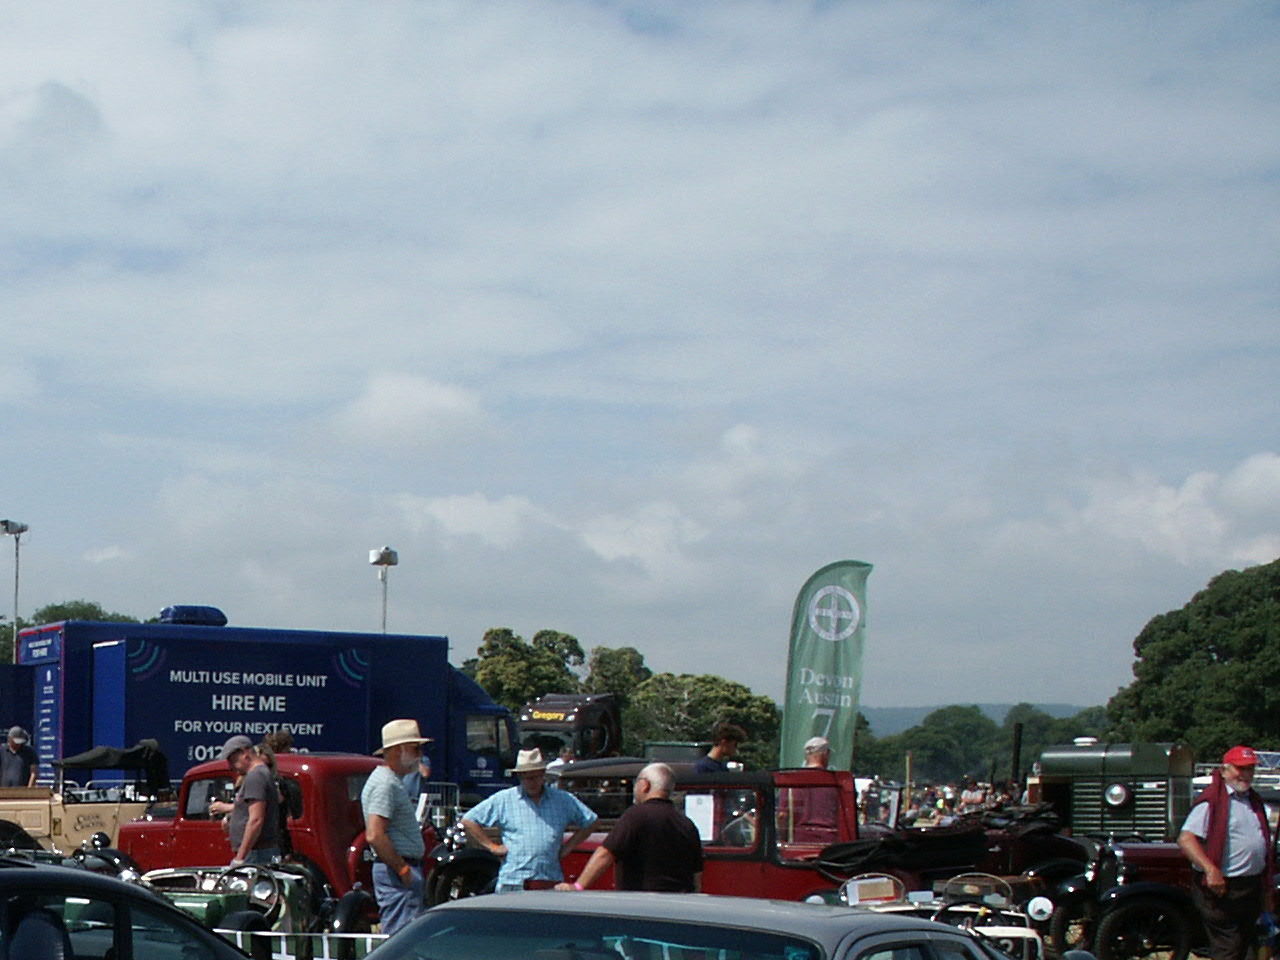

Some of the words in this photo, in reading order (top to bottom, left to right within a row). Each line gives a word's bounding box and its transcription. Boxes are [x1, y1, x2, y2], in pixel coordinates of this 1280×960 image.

[169, 669, 210, 684] MULTI
[212, 671, 240, 685] USE
[242, 672, 294, 687] MOBILE
[296, 674, 328, 688] UNIT
[800, 667, 854, 689] Devon
[211, 694, 255, 711] HIRE
[258, 695, 287, 712] ME
[799, 686, 852, 708] Austin
[174, 720, 202, 733] FOR
[204, 721, 243, 734] YOUR
[245, 722, 279, 735] NEXT
[281, 723, 324, 736] EVENT
[811, 707, 836, 738] 7
